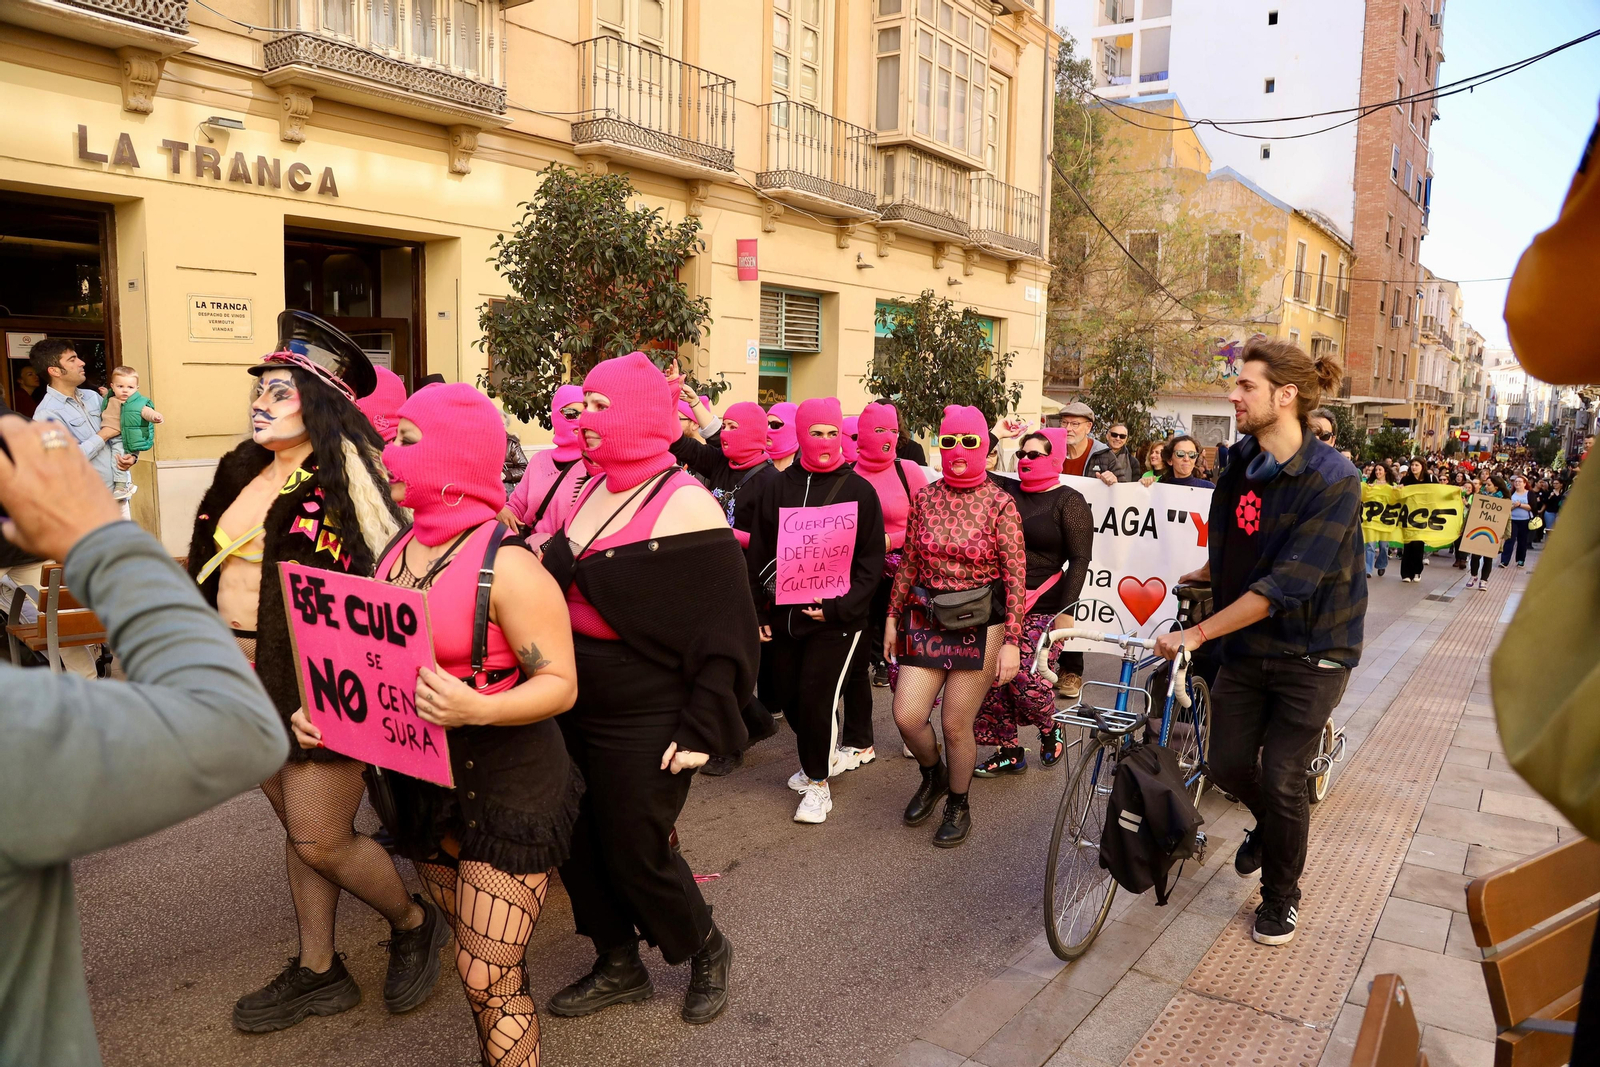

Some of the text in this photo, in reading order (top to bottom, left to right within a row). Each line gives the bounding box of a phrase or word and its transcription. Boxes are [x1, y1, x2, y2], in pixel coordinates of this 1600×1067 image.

[78, 124, 339, 197] LA TRANCA
[195, 301, 248, 311] LA TRANCA
[1478, 499, 1503, 512] TODO
[784, 511, 855, 534] CUERPAS
[802, 534, 818, 546] DE
[784, 544, 850, 562] DEFENSA
[797, 562, 826, 573] A LA
[781, 575, 845, 592] CULTURA
[288, 572, 418, 648] ESTE CULO
[926, 635, 980, 659] CULTURA
[365, 651, 383, 670] SE
[377, 682, 419, 718] CEN
[382, 716, 440, 759] SURA
